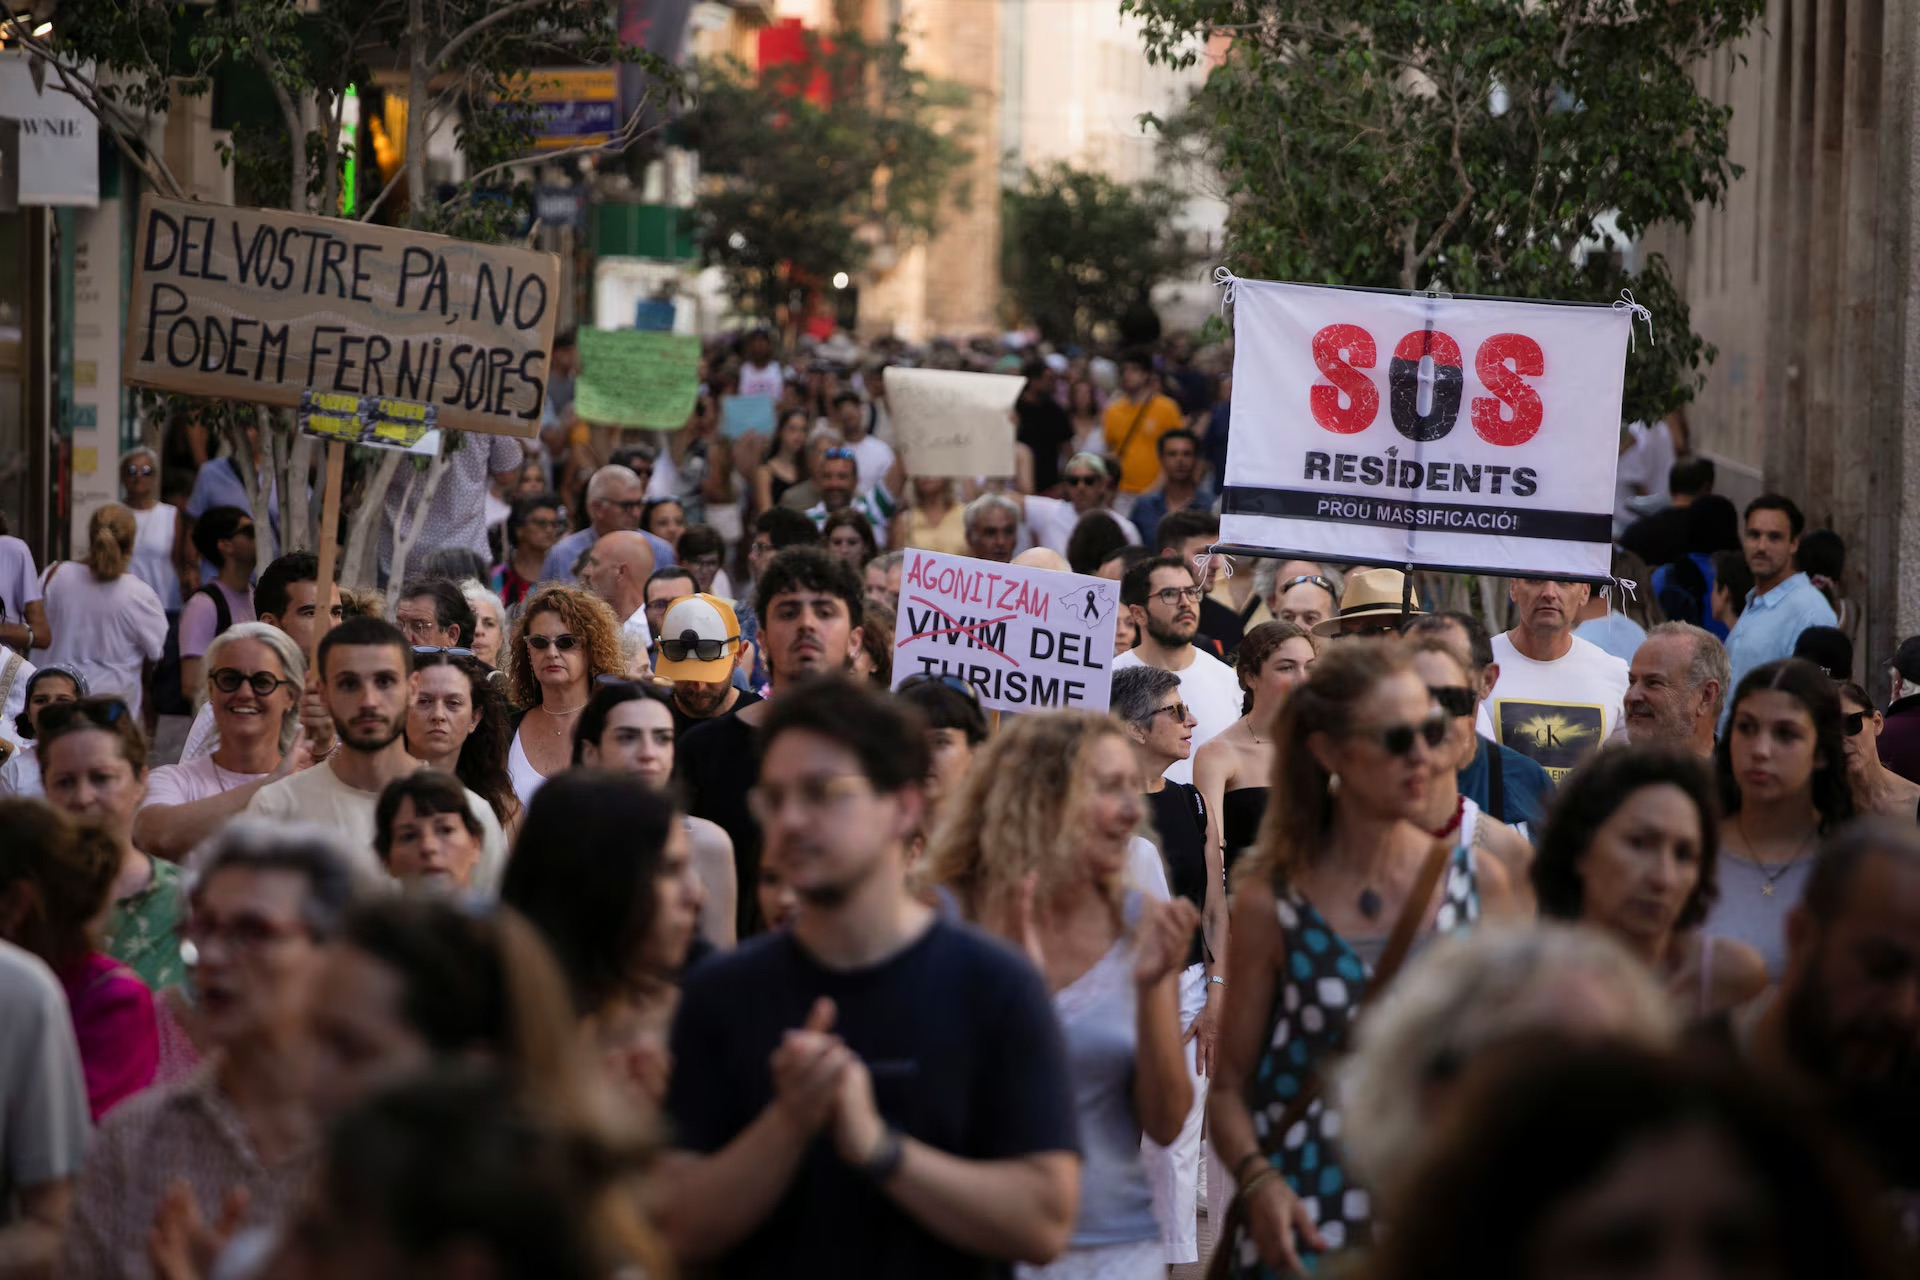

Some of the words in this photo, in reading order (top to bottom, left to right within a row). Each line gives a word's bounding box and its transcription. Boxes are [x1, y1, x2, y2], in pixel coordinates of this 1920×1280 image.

[396, 246, 459, 326] PA,
[471, 262, 548, 331] NO
[141, 283, 290, 384] PODEM
[1309, 322, 1545, 447] SOS
[1303, 447, 1538, 497] RESIDENTS
[1316, 500, 1372, 520] PROU
[1376, 504, 1519, 531] MASSIFICACIÓ!
[906, 553, 1050, 622] AGONITZAM
[907, 606, 1008, 655] VIVIM
[1029, 626, 1105, 670] DEL
